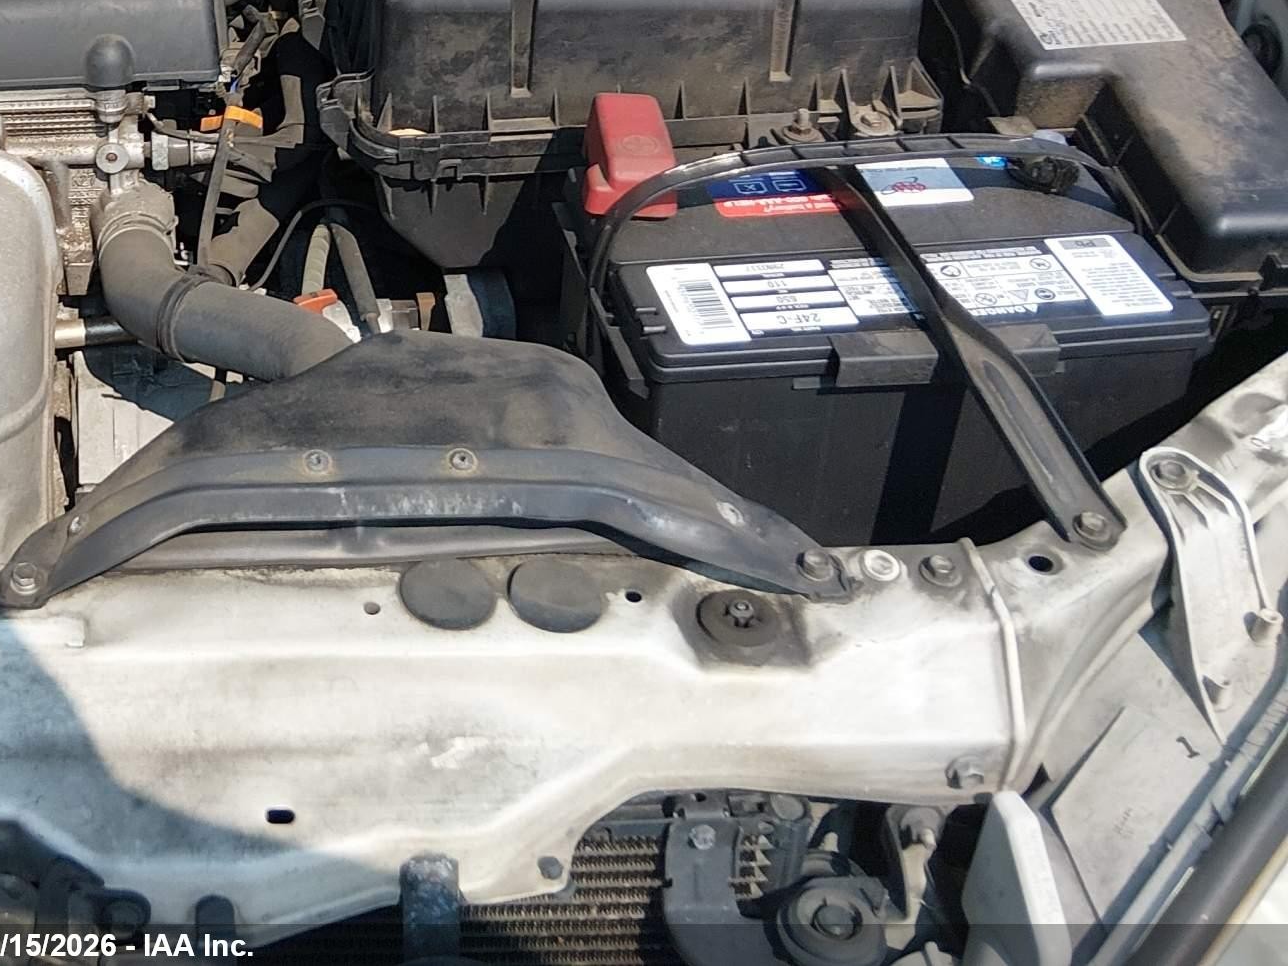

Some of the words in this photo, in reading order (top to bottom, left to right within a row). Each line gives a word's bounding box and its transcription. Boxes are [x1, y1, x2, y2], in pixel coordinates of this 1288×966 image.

[1074, 240, 1097, 248] Pb
[968, 305, 1027, 316] DANGER
[775, 313, 821, 325] 24F-C
